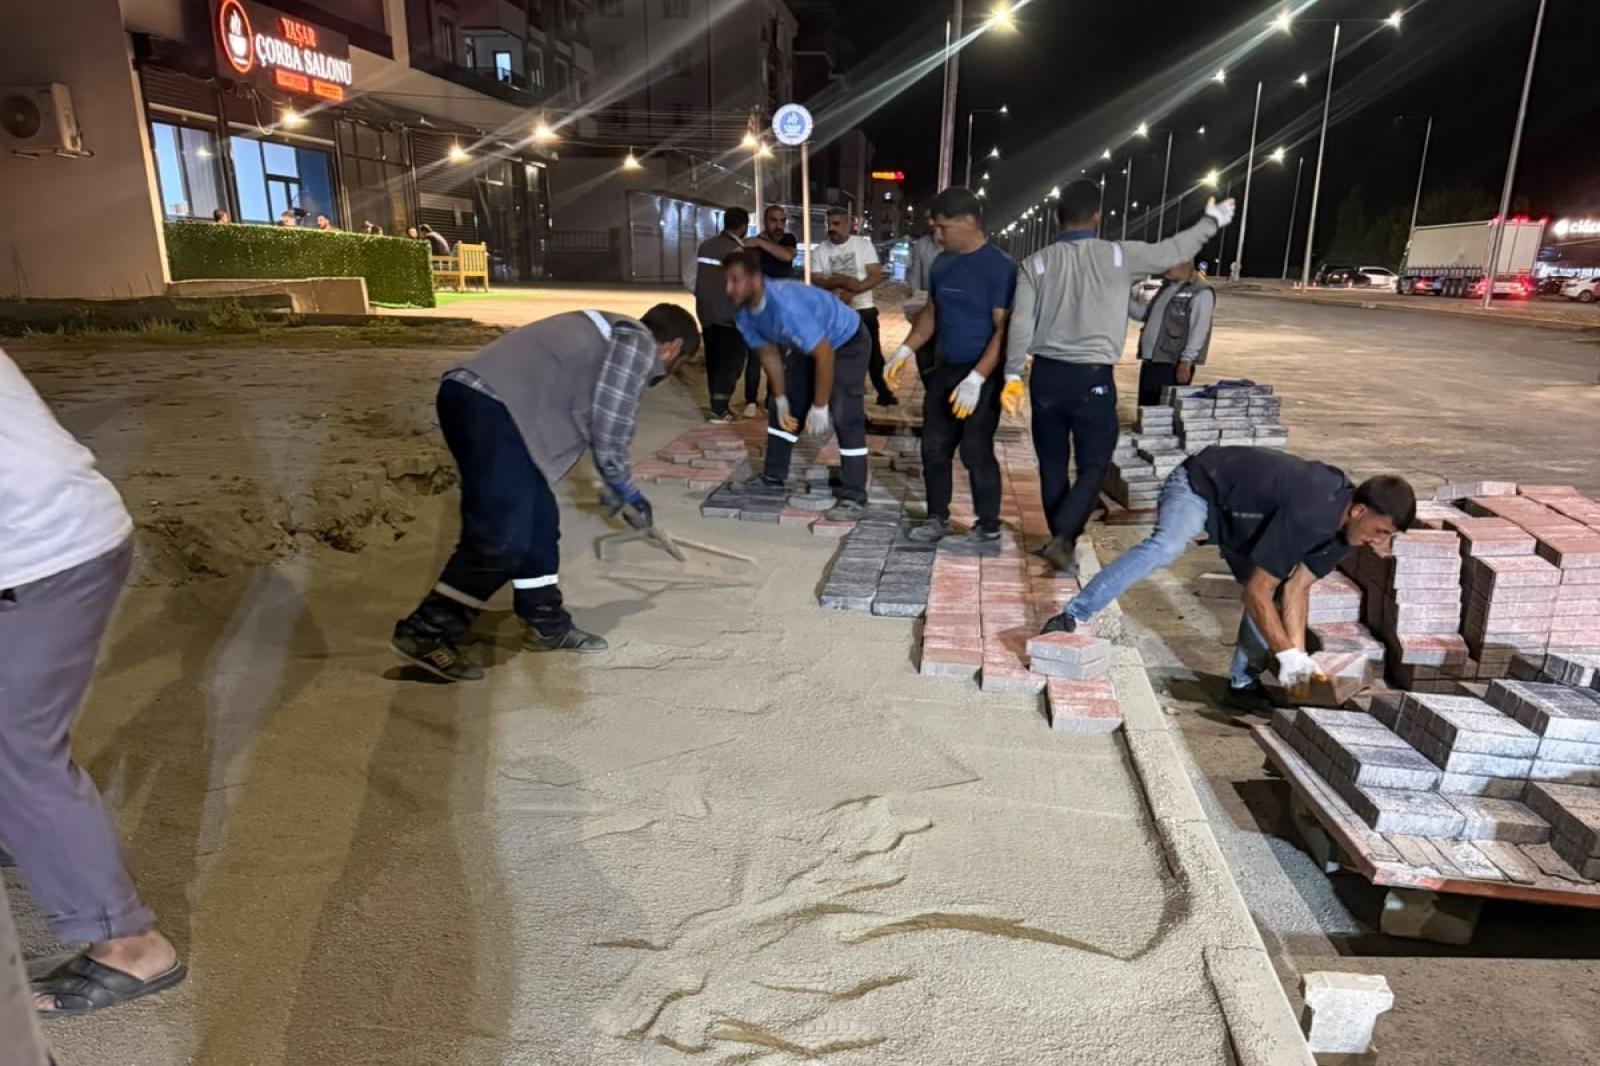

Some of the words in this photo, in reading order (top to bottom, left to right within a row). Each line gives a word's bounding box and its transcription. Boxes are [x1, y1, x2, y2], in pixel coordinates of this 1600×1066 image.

[281, 17, 316, 47] YAŞAR
[255, 33, 304, 71] ÇORBA
[304, 48, 352, 85] SALONU
